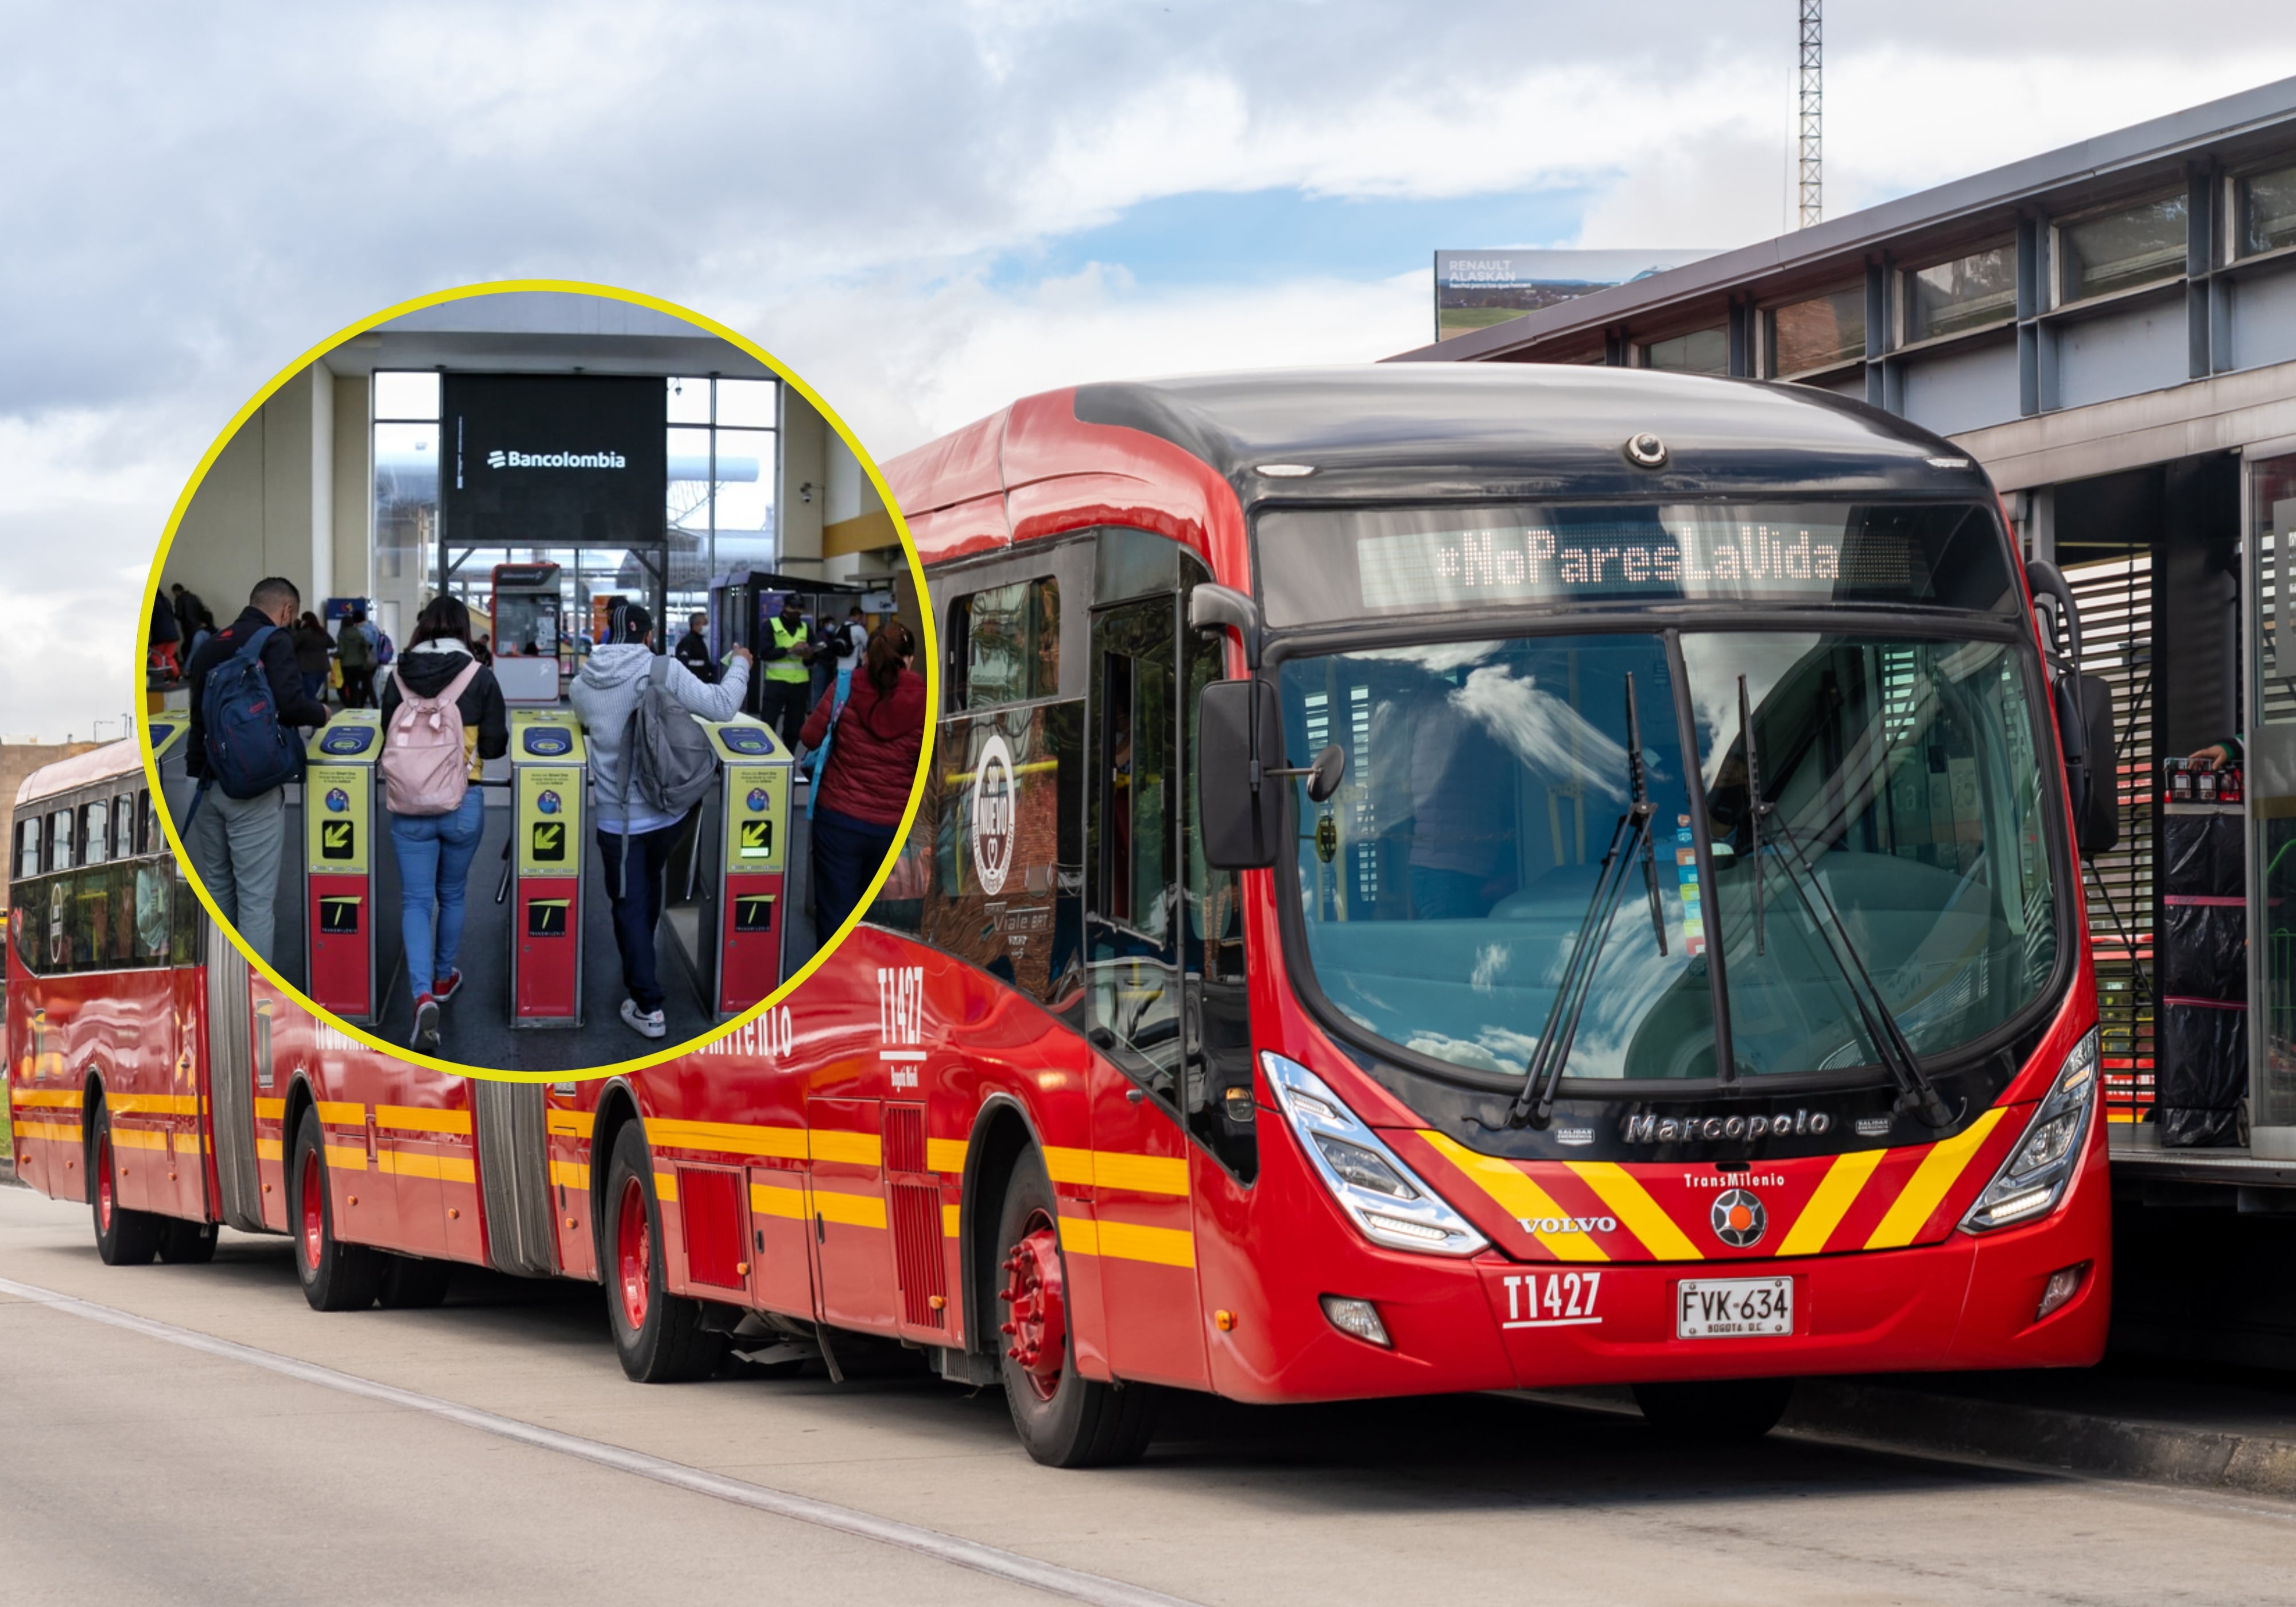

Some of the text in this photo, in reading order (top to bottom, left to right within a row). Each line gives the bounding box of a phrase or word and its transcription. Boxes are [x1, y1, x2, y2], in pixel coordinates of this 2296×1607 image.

[1449, 260, 1511, 270] RENAULT
[1449, 271, 1516, 281] ALASKAN
[508, 451, 626, 468] Bancolombia
[988, 765, 1000, 793] SOY
[979, 796, 1007, 836] NUEVO
[994, 911, 1048, 931] Viale BRT
[878, 966, 924, 1044] T1427
[1624, 1108, 1830, 1143] Marcopolo
[1684, 1173, 1785, 1187] TransMilenio
[1517, 1216, 1617, 1233] VOLVO
[1503, 1272, 1601, 1319] T1427
[1708, 1321, 1765, 1333] BOGOTA D.C.
